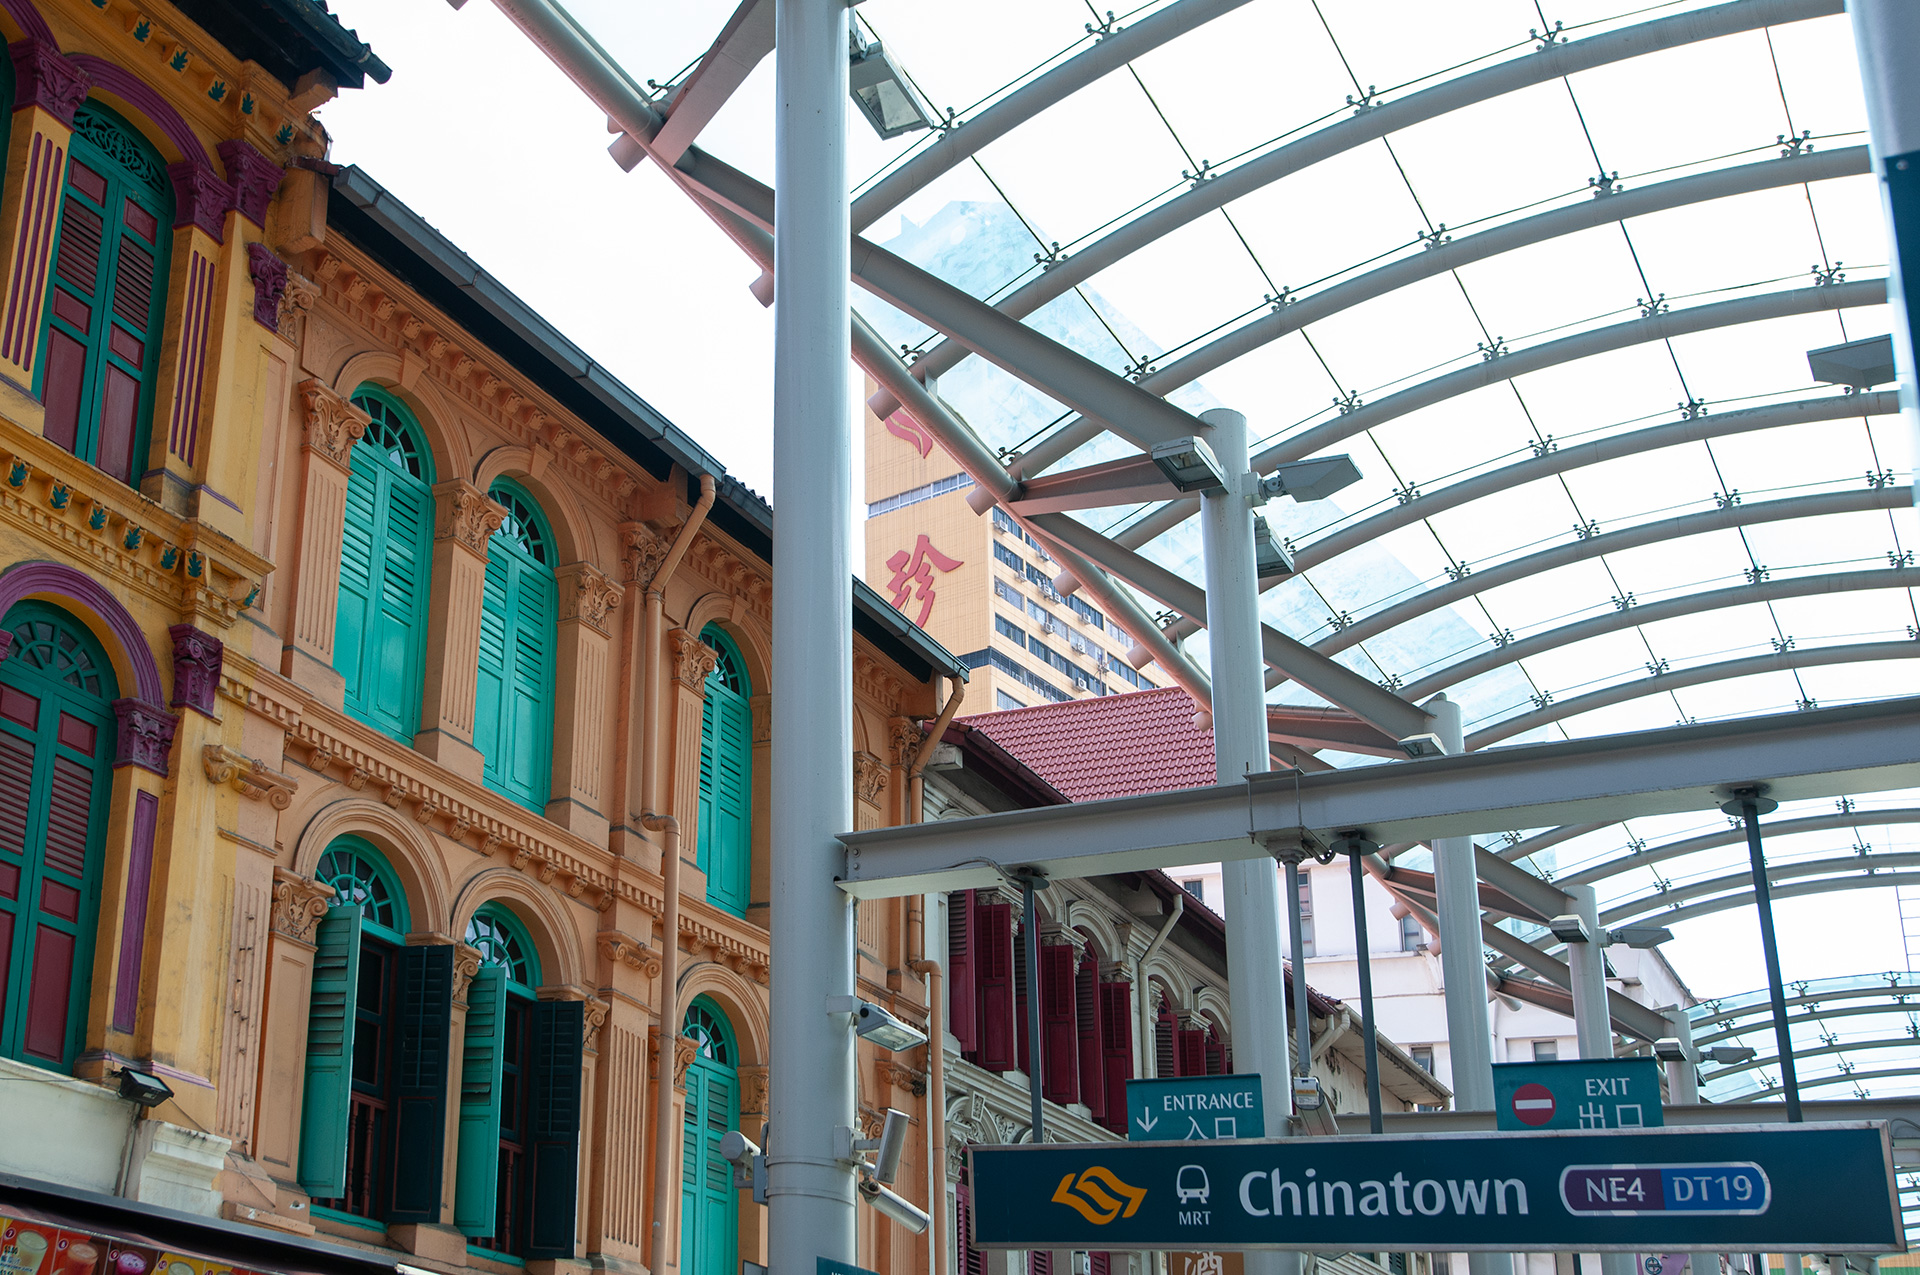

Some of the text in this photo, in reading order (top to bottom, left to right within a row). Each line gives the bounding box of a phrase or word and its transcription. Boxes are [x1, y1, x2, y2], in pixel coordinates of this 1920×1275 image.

[886, 535, 964, 628] 珍
[1585, 1078, 1630, 1096] EXIT
[1163, 1092, 1254, 1111] ENTRANCE
[1579, 1102, 1643, 1128] 出口
[1184, 1116, 1237, 1140] 入口
[1239, 1168, 1752, 1217] Chinatown NE4 DT19
[1179, 1211, 1211, 1225] MRT
